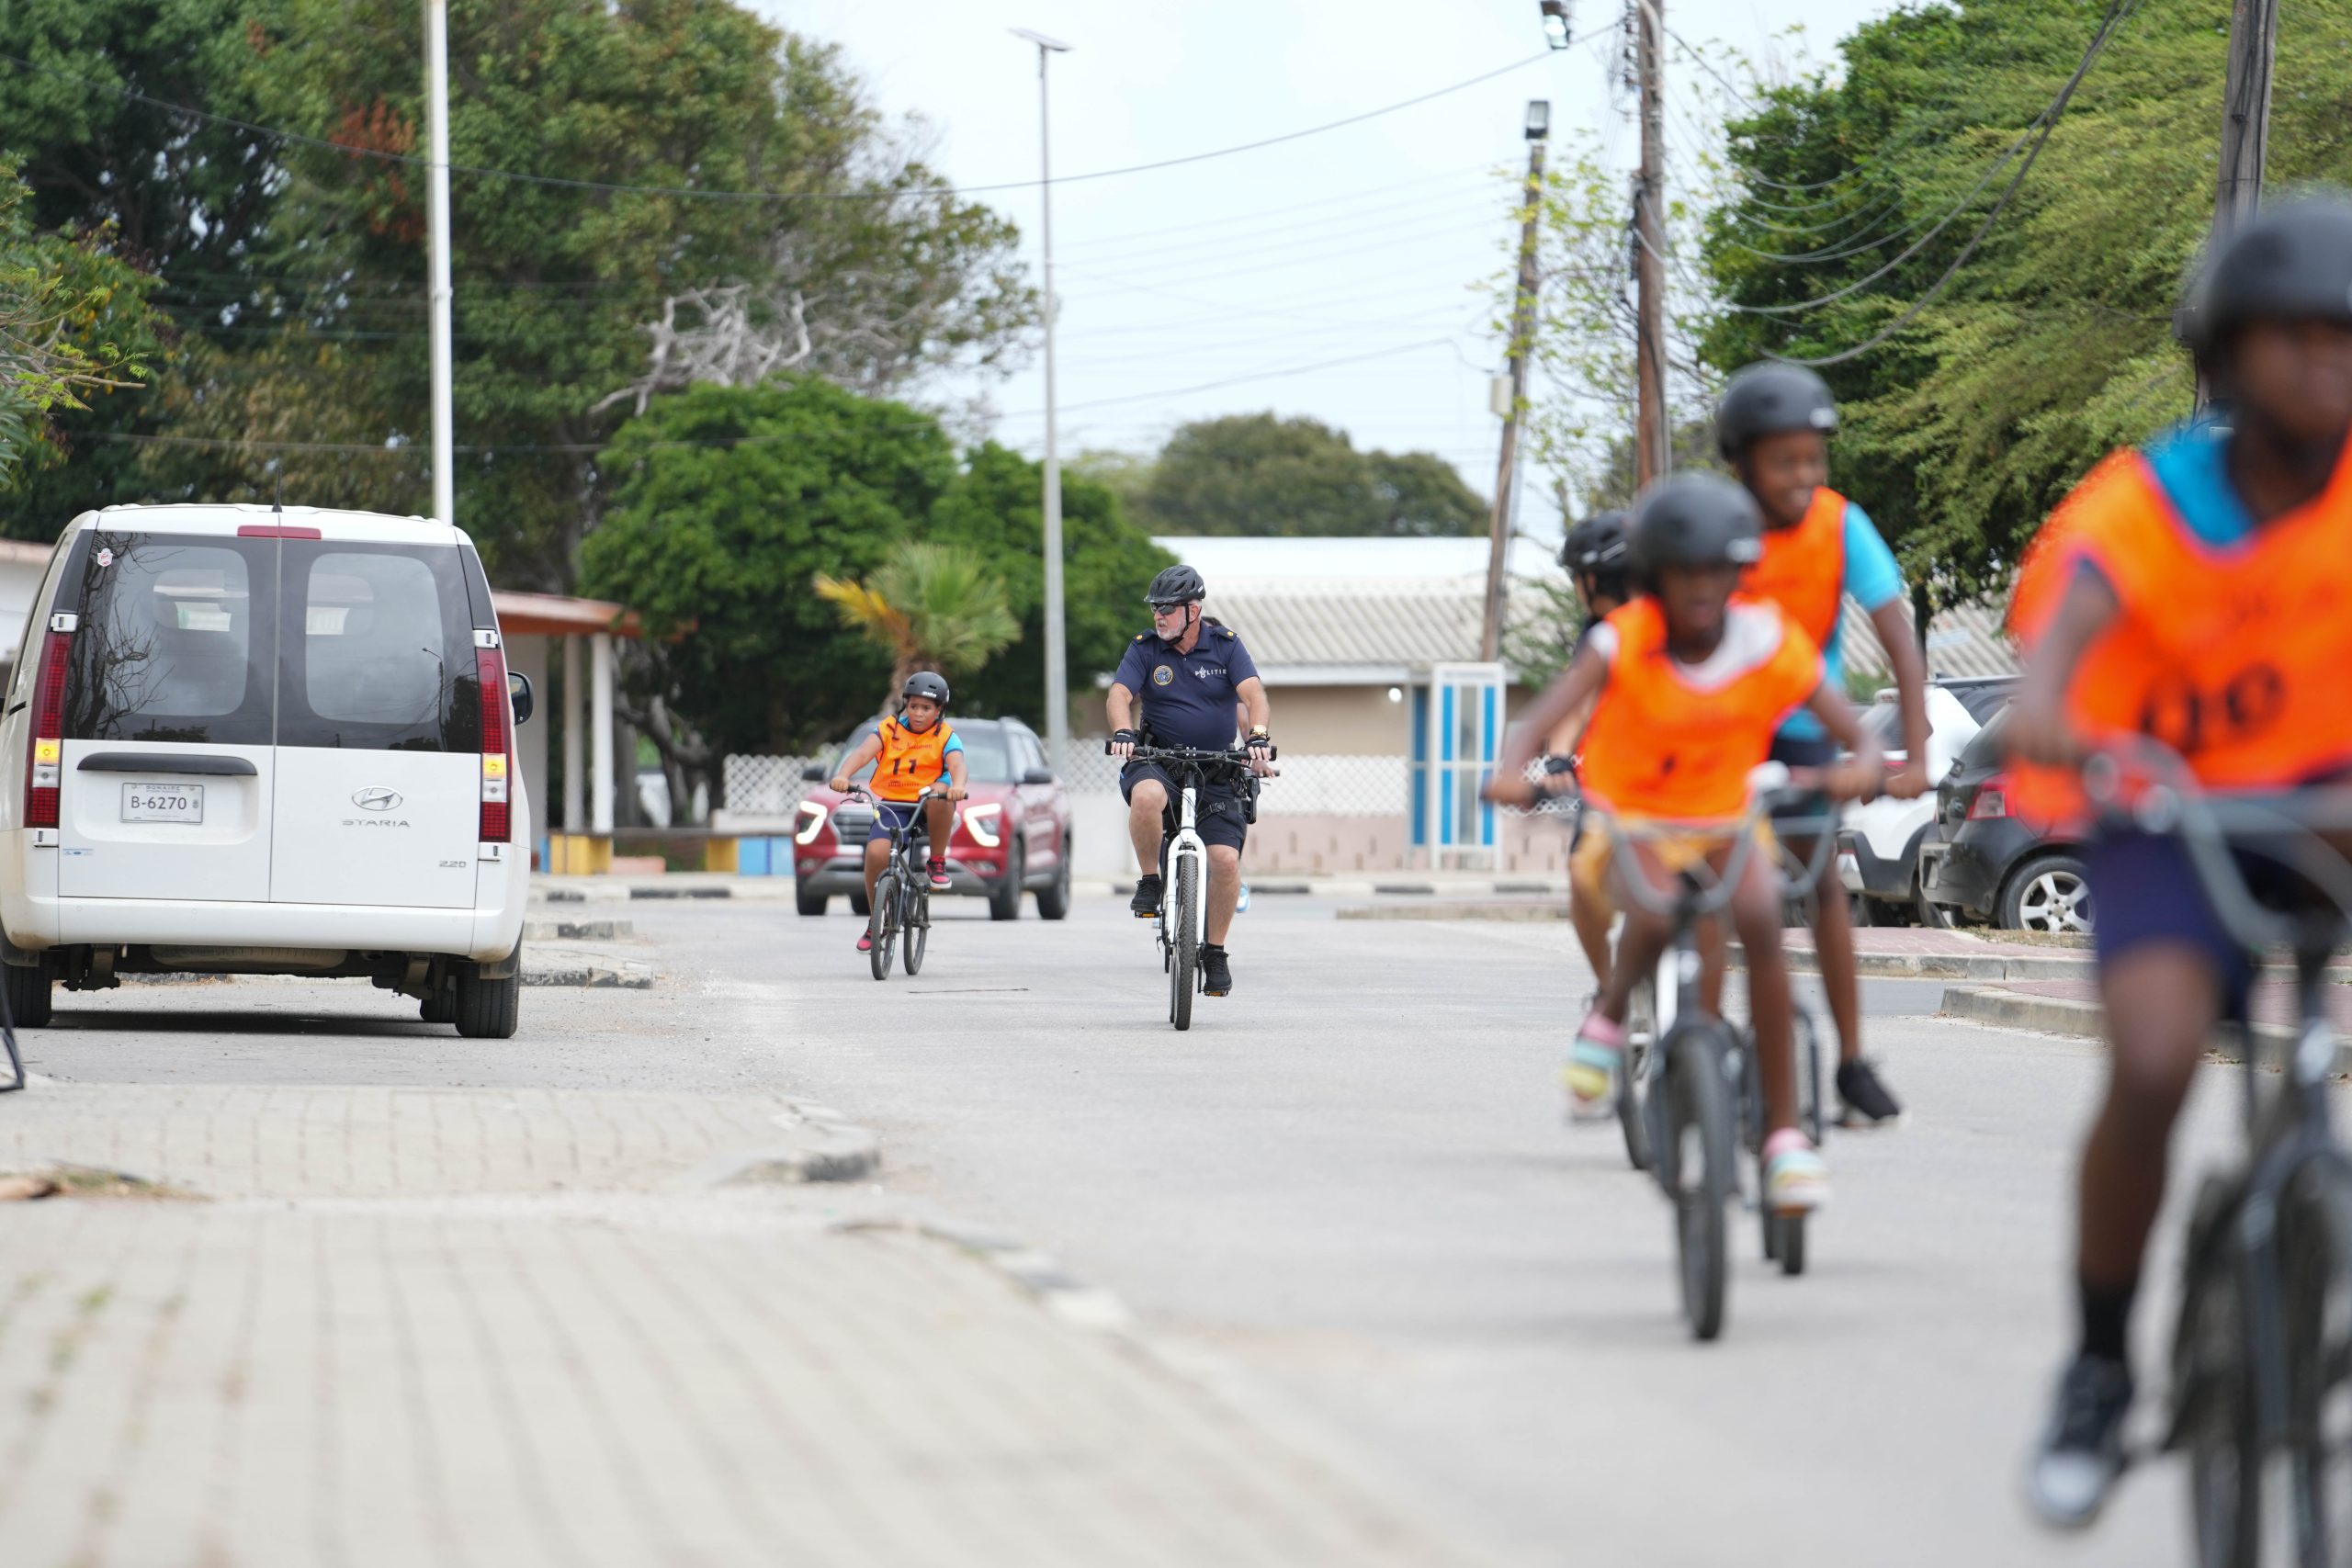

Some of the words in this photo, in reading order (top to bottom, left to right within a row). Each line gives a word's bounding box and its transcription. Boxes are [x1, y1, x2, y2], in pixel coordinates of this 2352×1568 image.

[893, 759, 917, 775] 11
[131, 795, 187, 809] B-6270
[342, 819, 411, 828] STARIA
